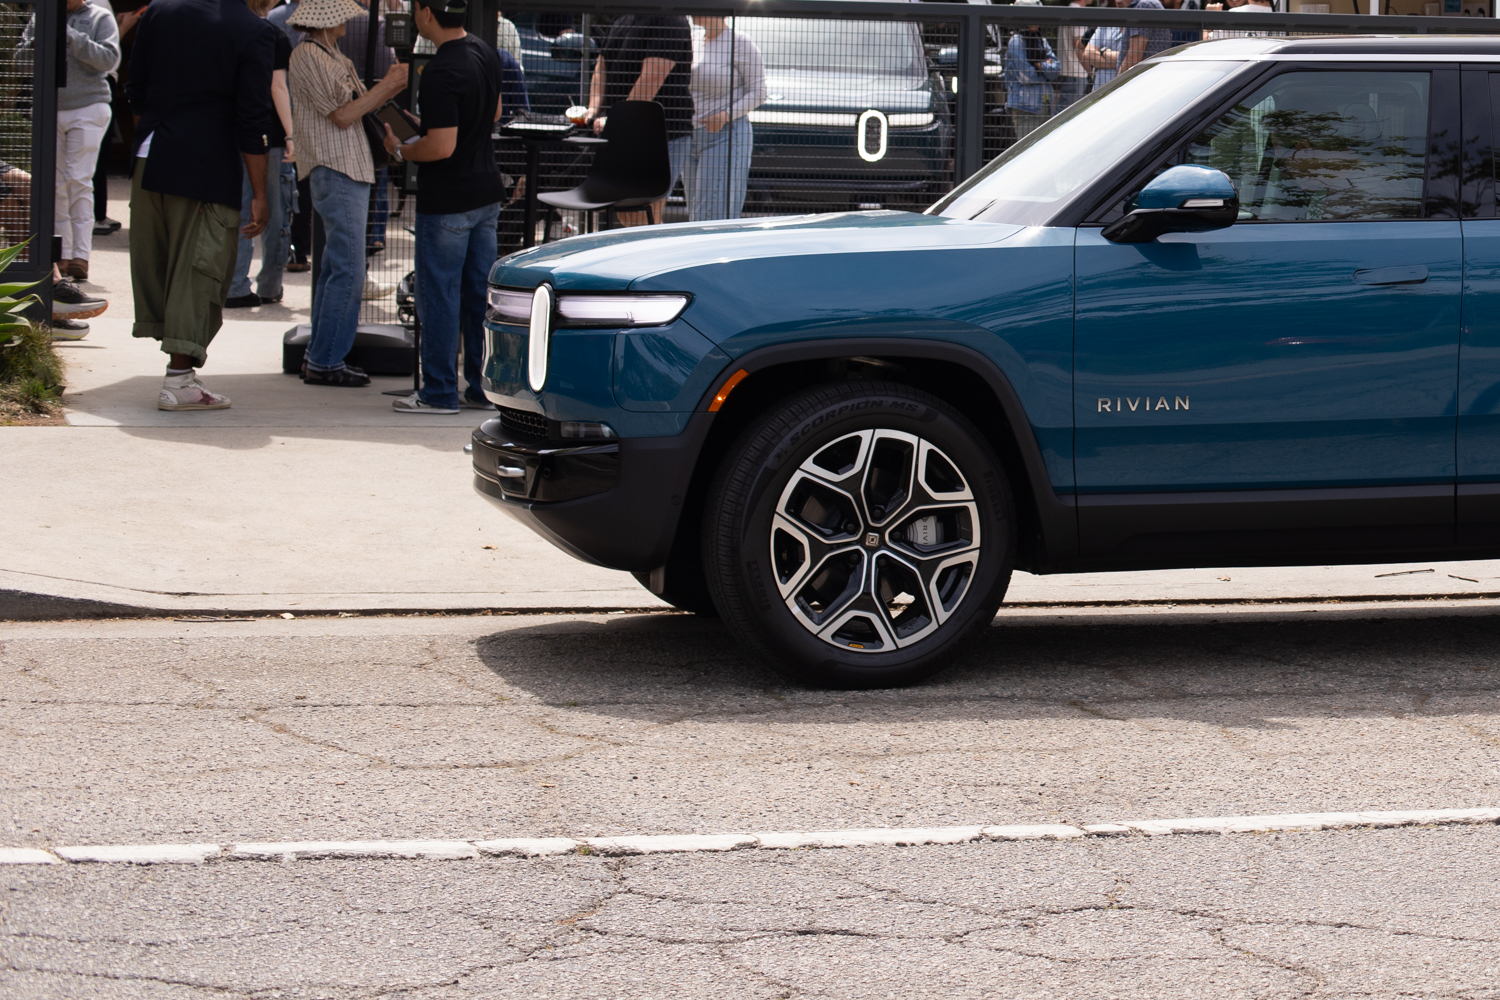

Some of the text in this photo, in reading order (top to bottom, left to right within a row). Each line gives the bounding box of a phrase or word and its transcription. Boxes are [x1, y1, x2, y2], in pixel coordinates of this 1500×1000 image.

[790, 399, 919, 446] SCORPION MS
[1097, 396, 1190, 413] RIVIAN
[982, 470, 1008, 522] PIRELLI
